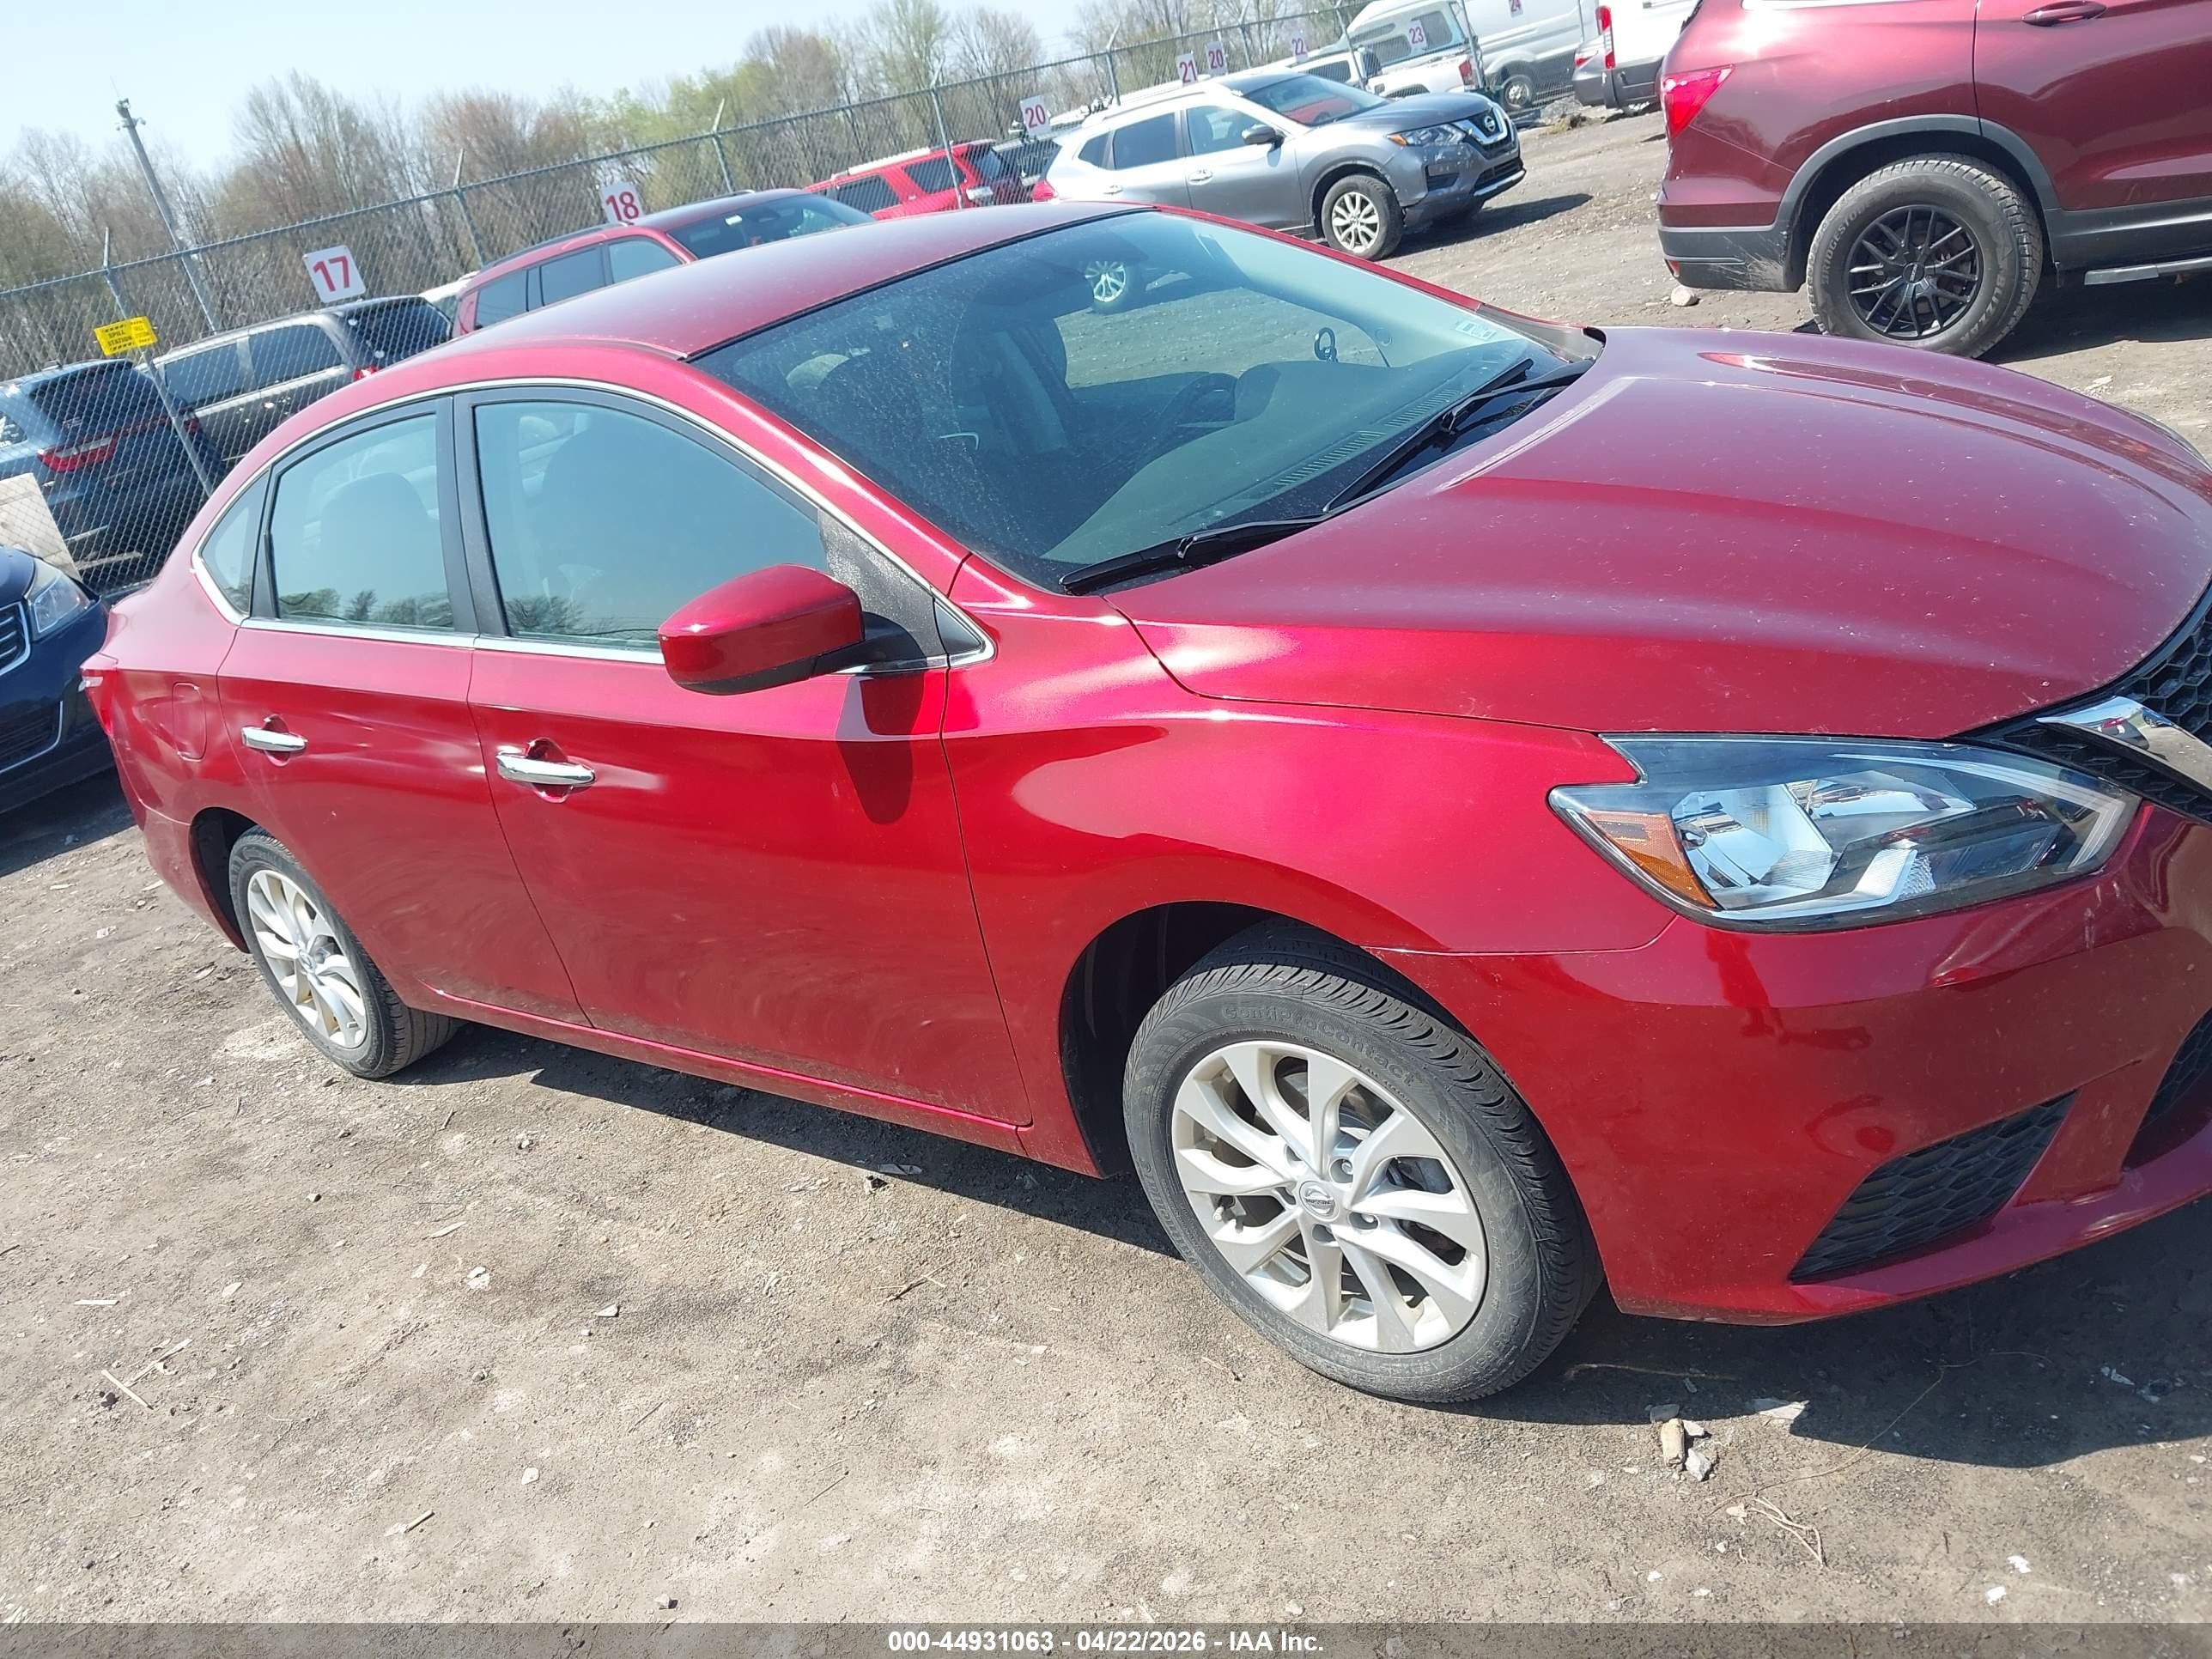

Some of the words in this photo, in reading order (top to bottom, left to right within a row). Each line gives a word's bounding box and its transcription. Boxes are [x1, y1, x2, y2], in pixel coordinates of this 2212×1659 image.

[1409, 27, 1424, 44] 23
[1180, 59, 1197, 83] 21
[1208, 49, 1223, 69] 20
[1025, 104, 1045, 128] 20
[605, 191, 639, 221] 18
[313, 255, 349, 292] 17
